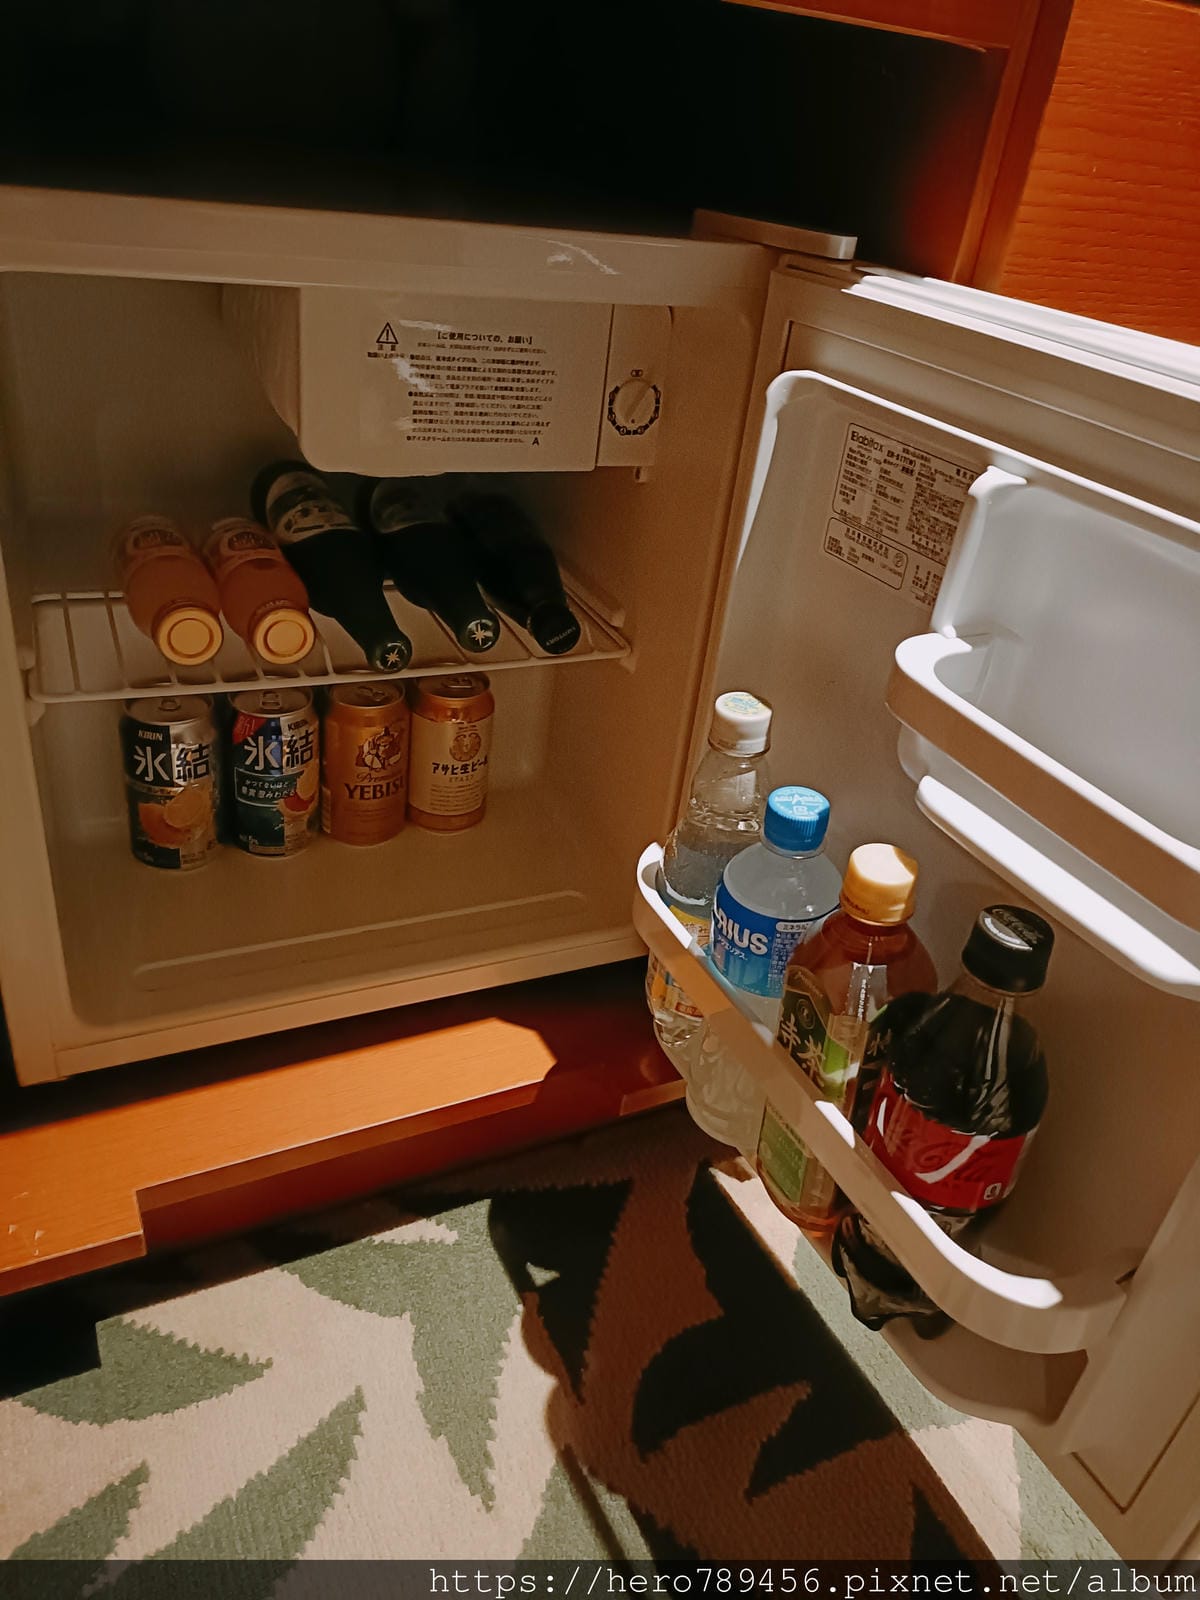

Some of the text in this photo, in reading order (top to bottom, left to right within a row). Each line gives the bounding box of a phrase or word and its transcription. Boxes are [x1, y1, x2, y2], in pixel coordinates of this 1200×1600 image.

[532, 437, 540, 446] A
[138, 729, 163, 742] KIRIN
[133, 743, 211, 782] 氷結
[243, 730, 314, 771] 氷結
